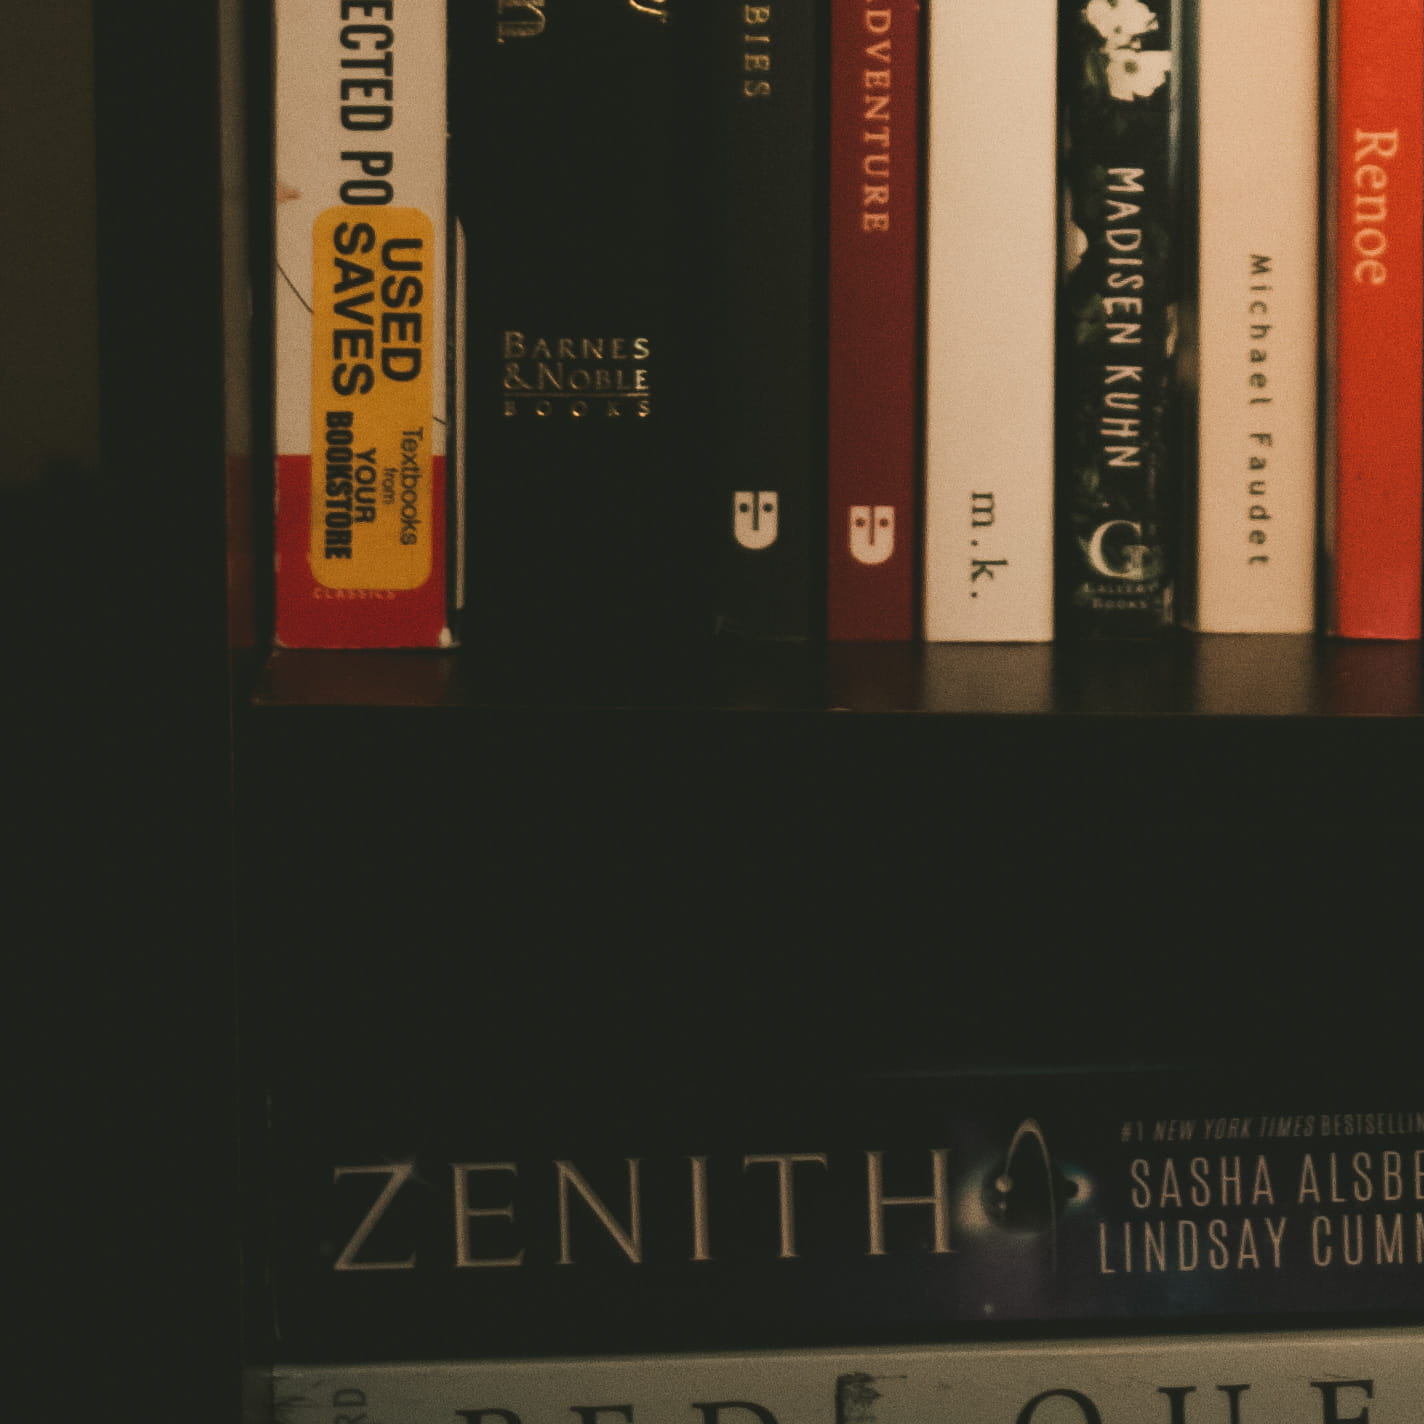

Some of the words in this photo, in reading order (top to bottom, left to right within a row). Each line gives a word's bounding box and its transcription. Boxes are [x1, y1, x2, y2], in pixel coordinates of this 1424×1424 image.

[332, 220, 375, 396] SAVES
[380, 237, 424, 383] USED
[1102, 165, 1145, 347] MADISEN
[1248, 252, 1273, 407] Michael
[1101, 362, 1144, 472] KUHN
[325, 410, 353, 560] BOOKSTORE
[354, 448, 377, 523] YOUR
[381, 467, 399, 504] from
[399, 426, 424, 546] Textbooks
[969, 489, 1010, 600] m.k.
[1246, 431, 1273, 567] Faudet
[331, 1148, 959, 1272] ZENITH
[1129, 1154, 1275, 1210] SASHA
[1098, 1215, 1289, 1276] LINDSAY
